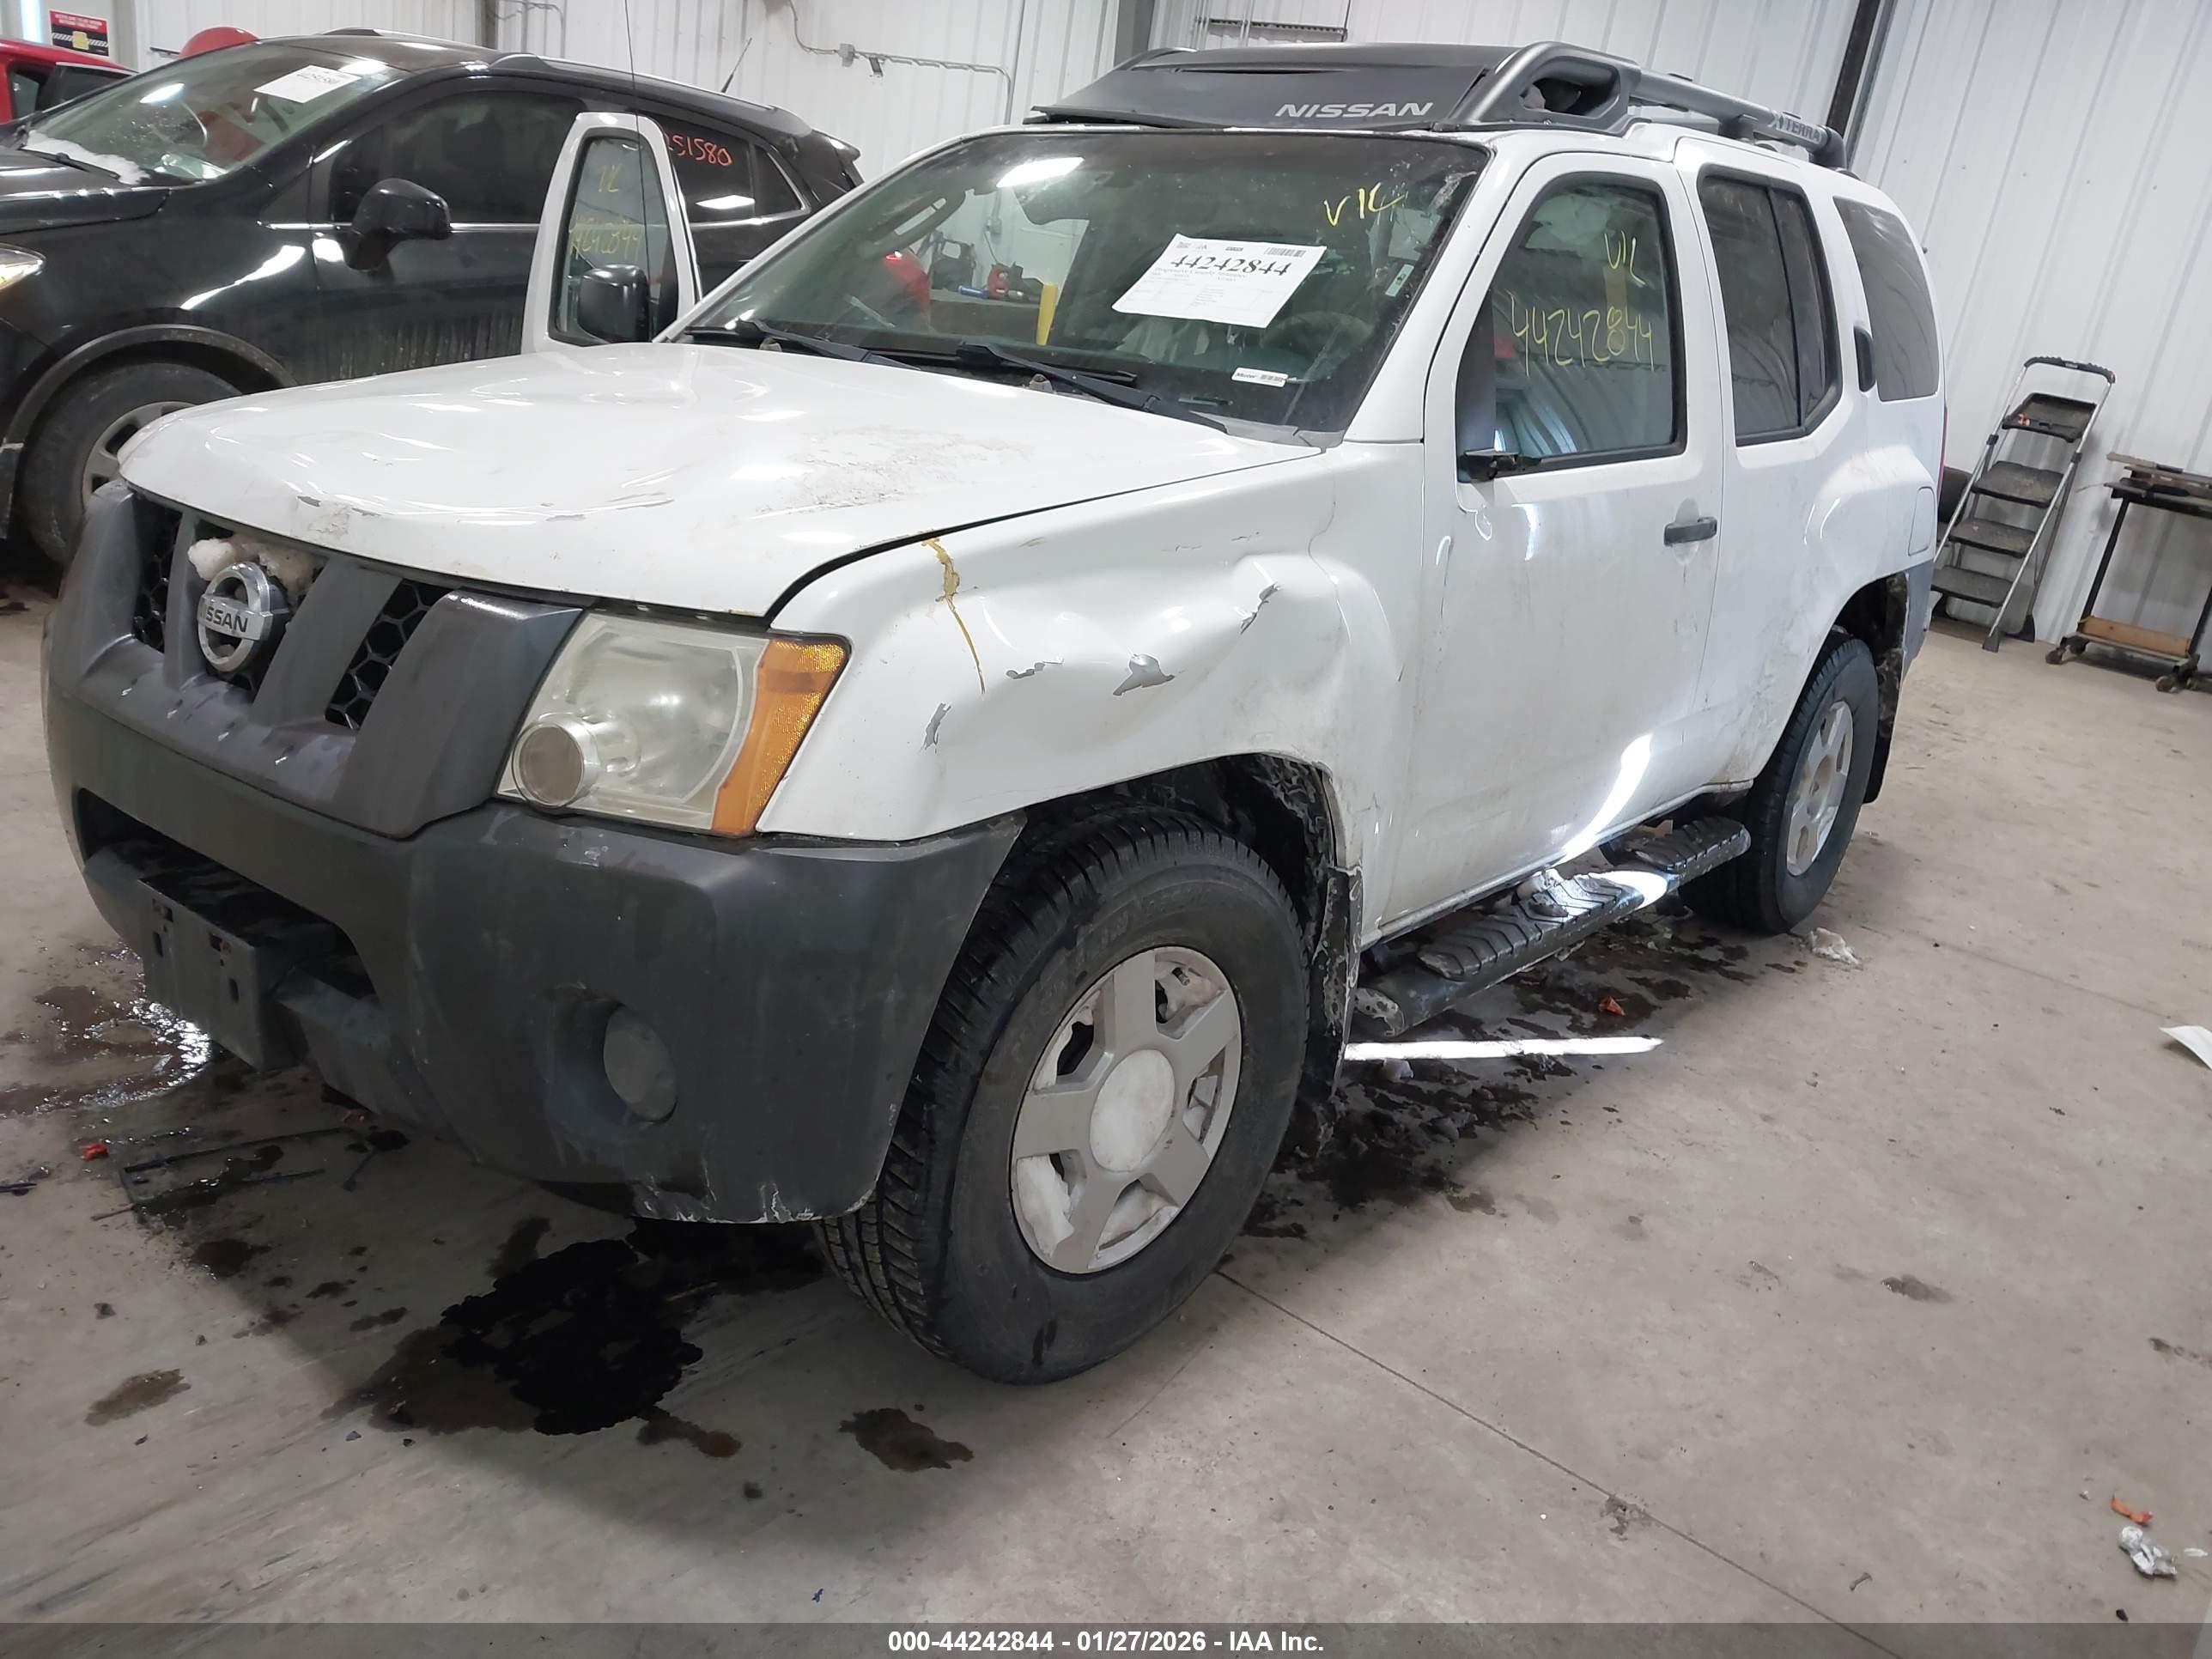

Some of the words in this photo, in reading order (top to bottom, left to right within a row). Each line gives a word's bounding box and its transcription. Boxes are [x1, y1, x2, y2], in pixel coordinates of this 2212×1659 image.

[1275, 101, 1434, 118] NISSAN
[1767, 110, 1821, 144] XTERRA
[1170, 254, 1292, 276] 44242844
[1504, 289, 1655, 378] 44242844
[198, 605, 248, 633] ISSAN
